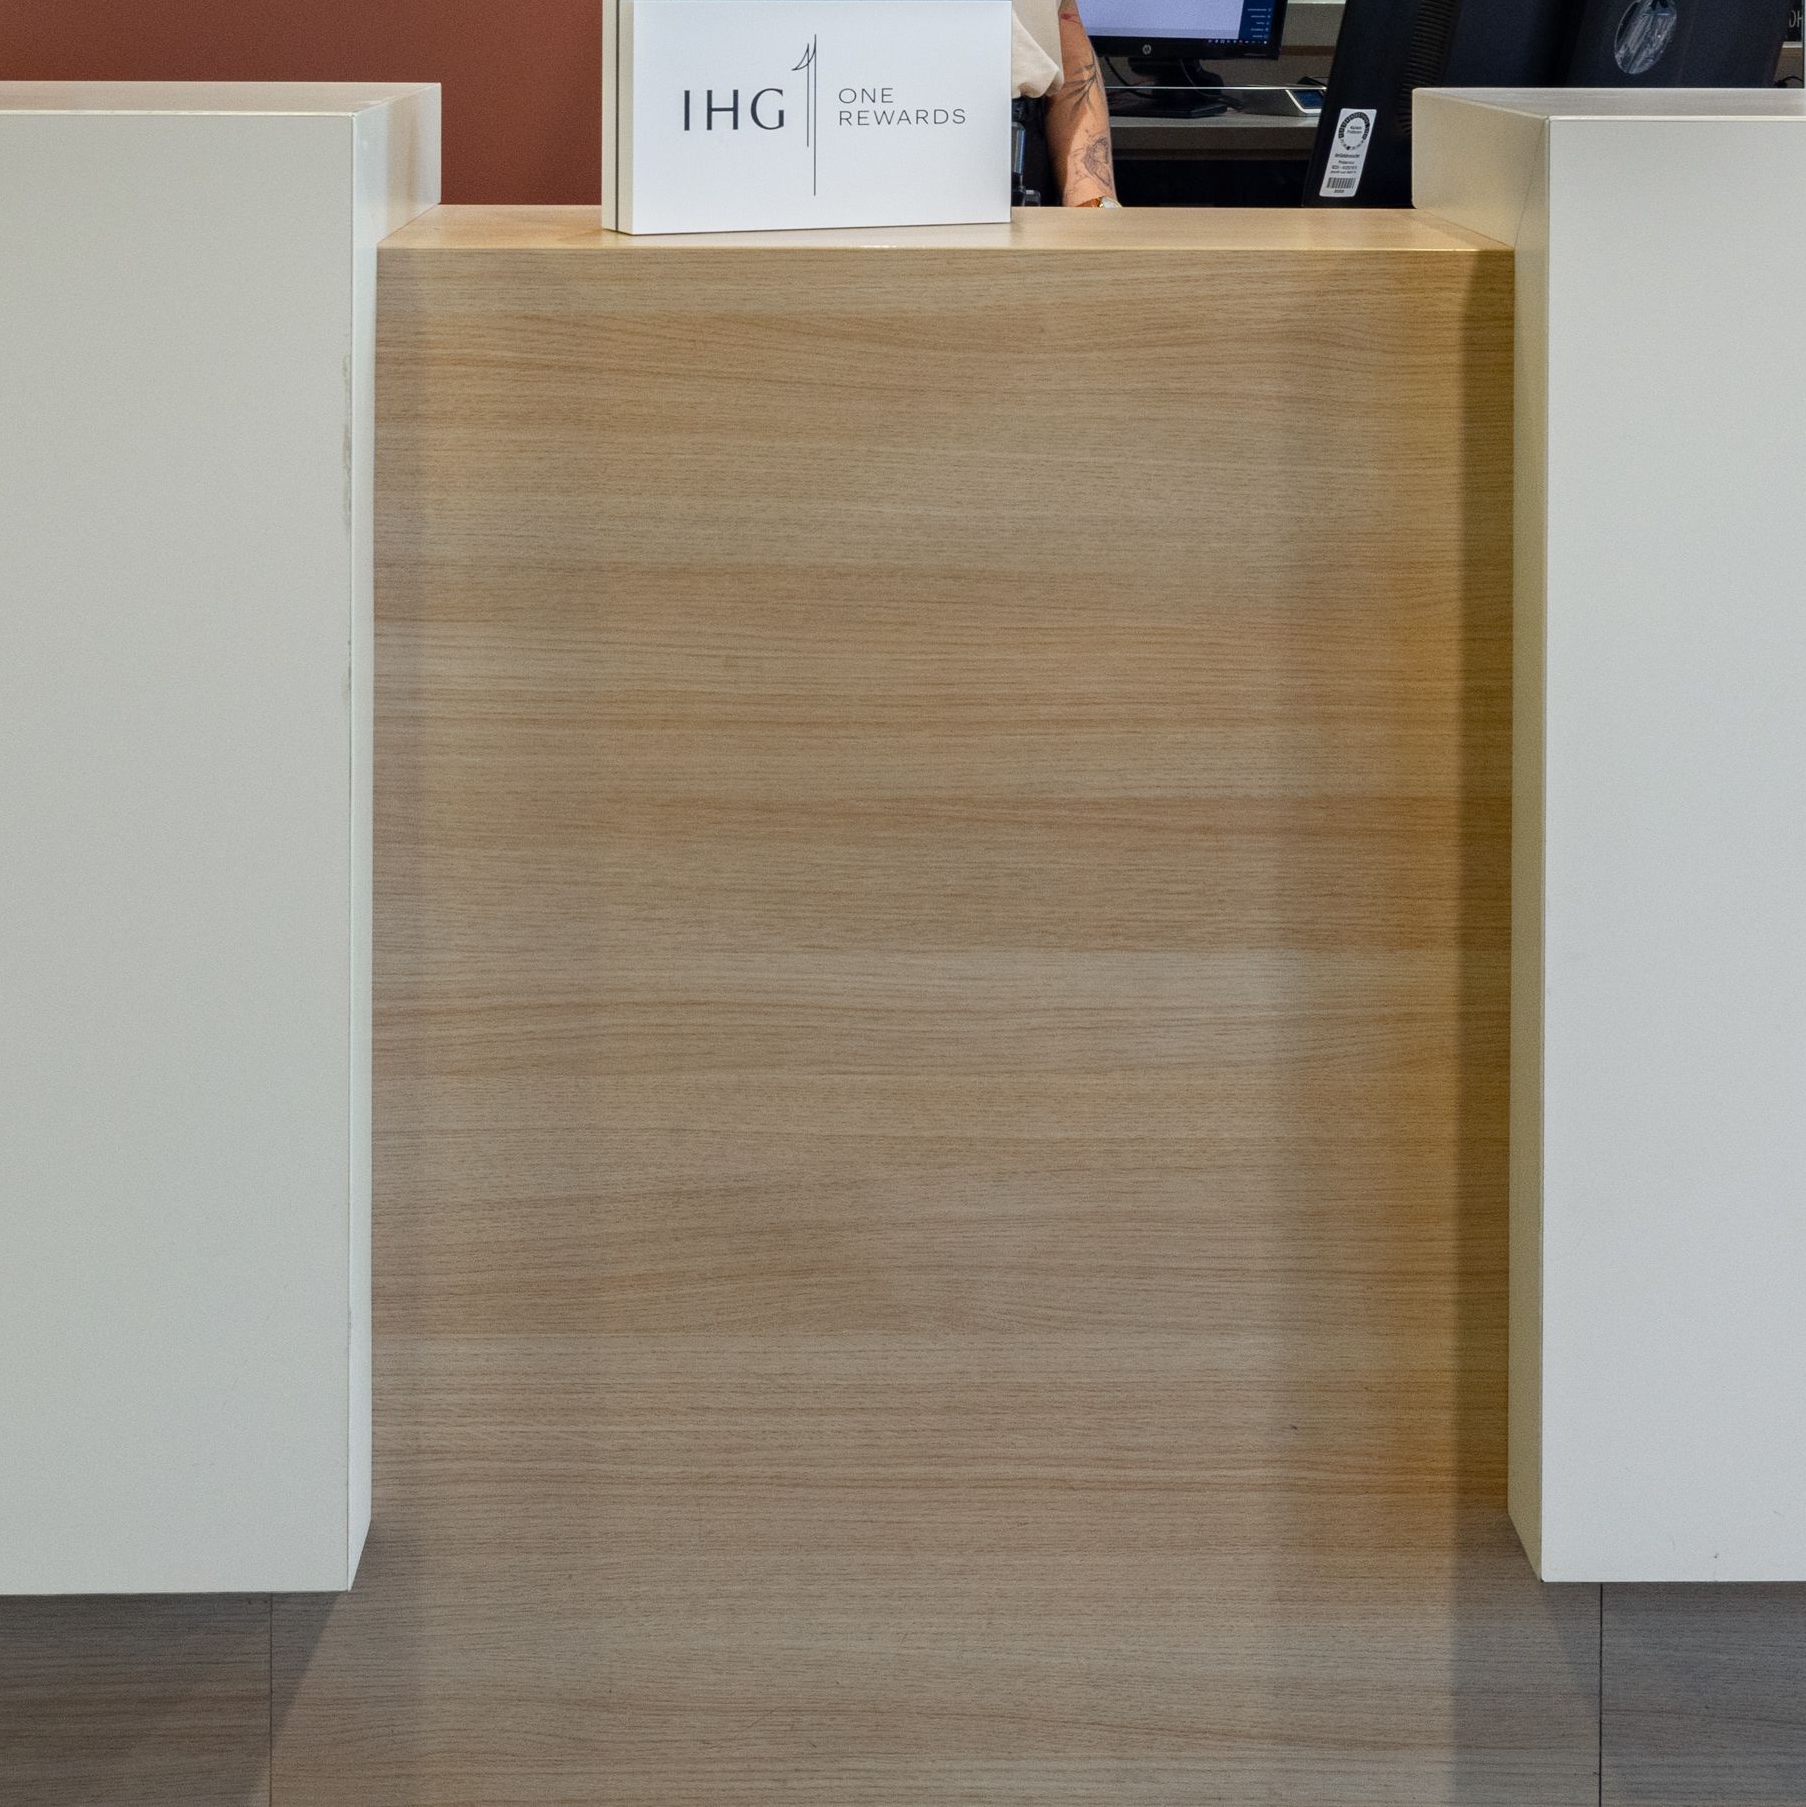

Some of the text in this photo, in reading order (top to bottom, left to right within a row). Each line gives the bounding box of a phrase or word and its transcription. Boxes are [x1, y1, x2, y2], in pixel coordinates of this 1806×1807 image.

[683, 87, 894, 131] IHG ONE
[839, 108, 967, 126] REWARDS
